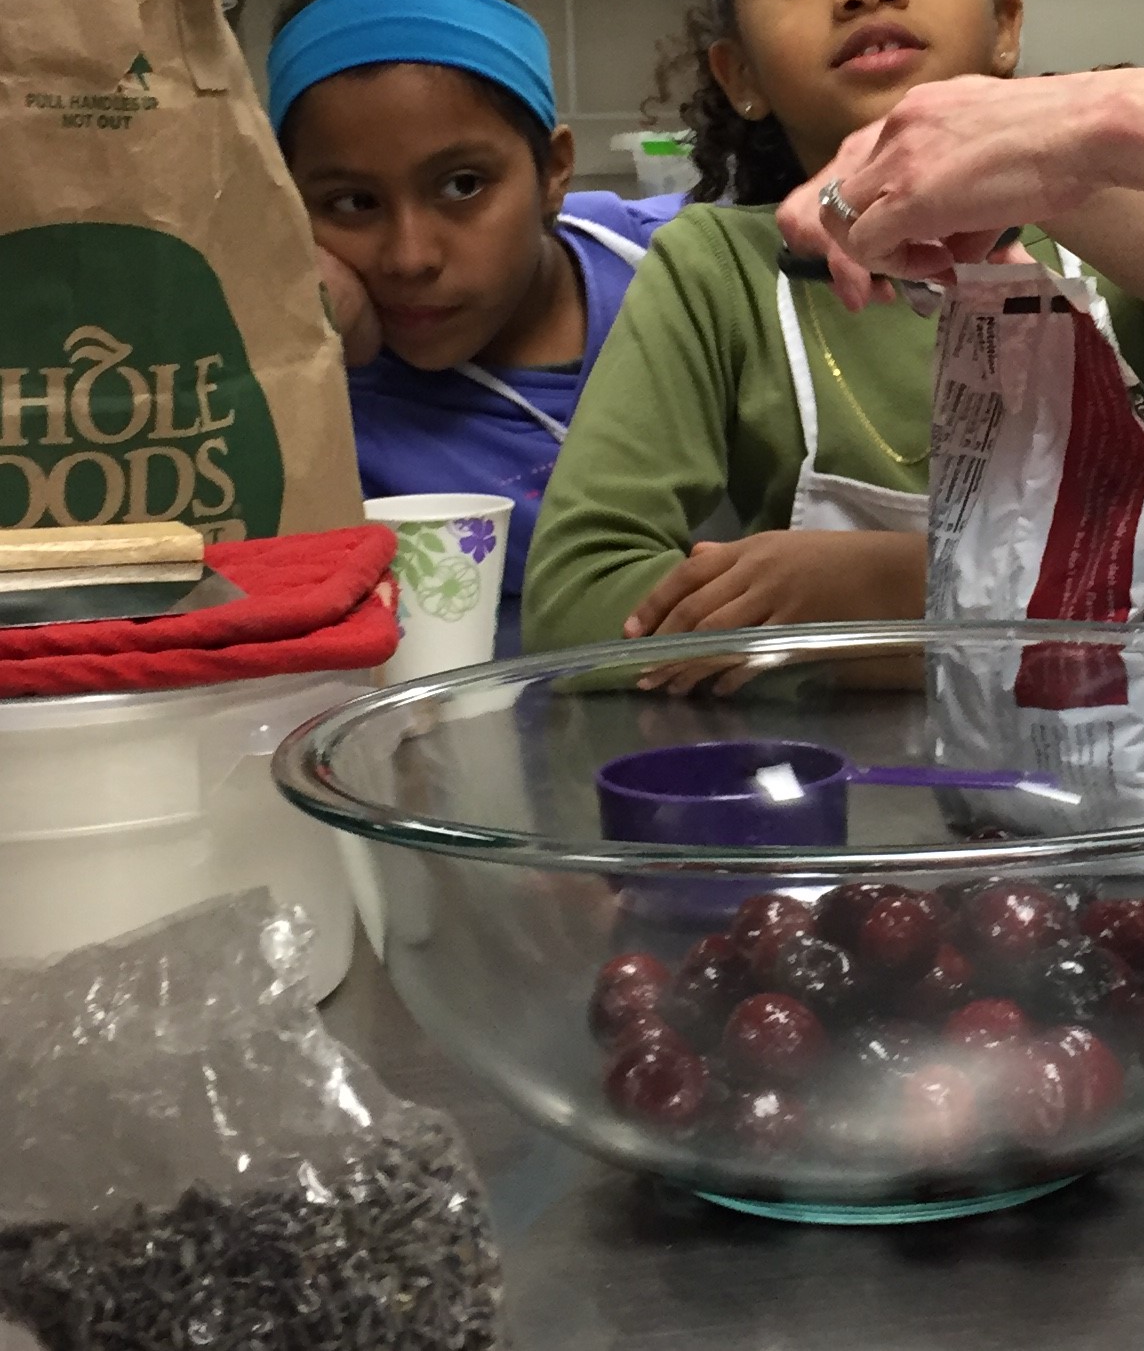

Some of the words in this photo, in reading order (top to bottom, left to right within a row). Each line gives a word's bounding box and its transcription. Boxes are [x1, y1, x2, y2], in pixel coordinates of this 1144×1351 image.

[25, 92, 65, 109] PULL
[62, 113, 93, 129] NOT
[96, 115, 133, 130] OUT
[986, 316, 997, 375] Nutrition
[0, 352, 236, 446] HOLE
[0, 436, 238, 530] OODS
